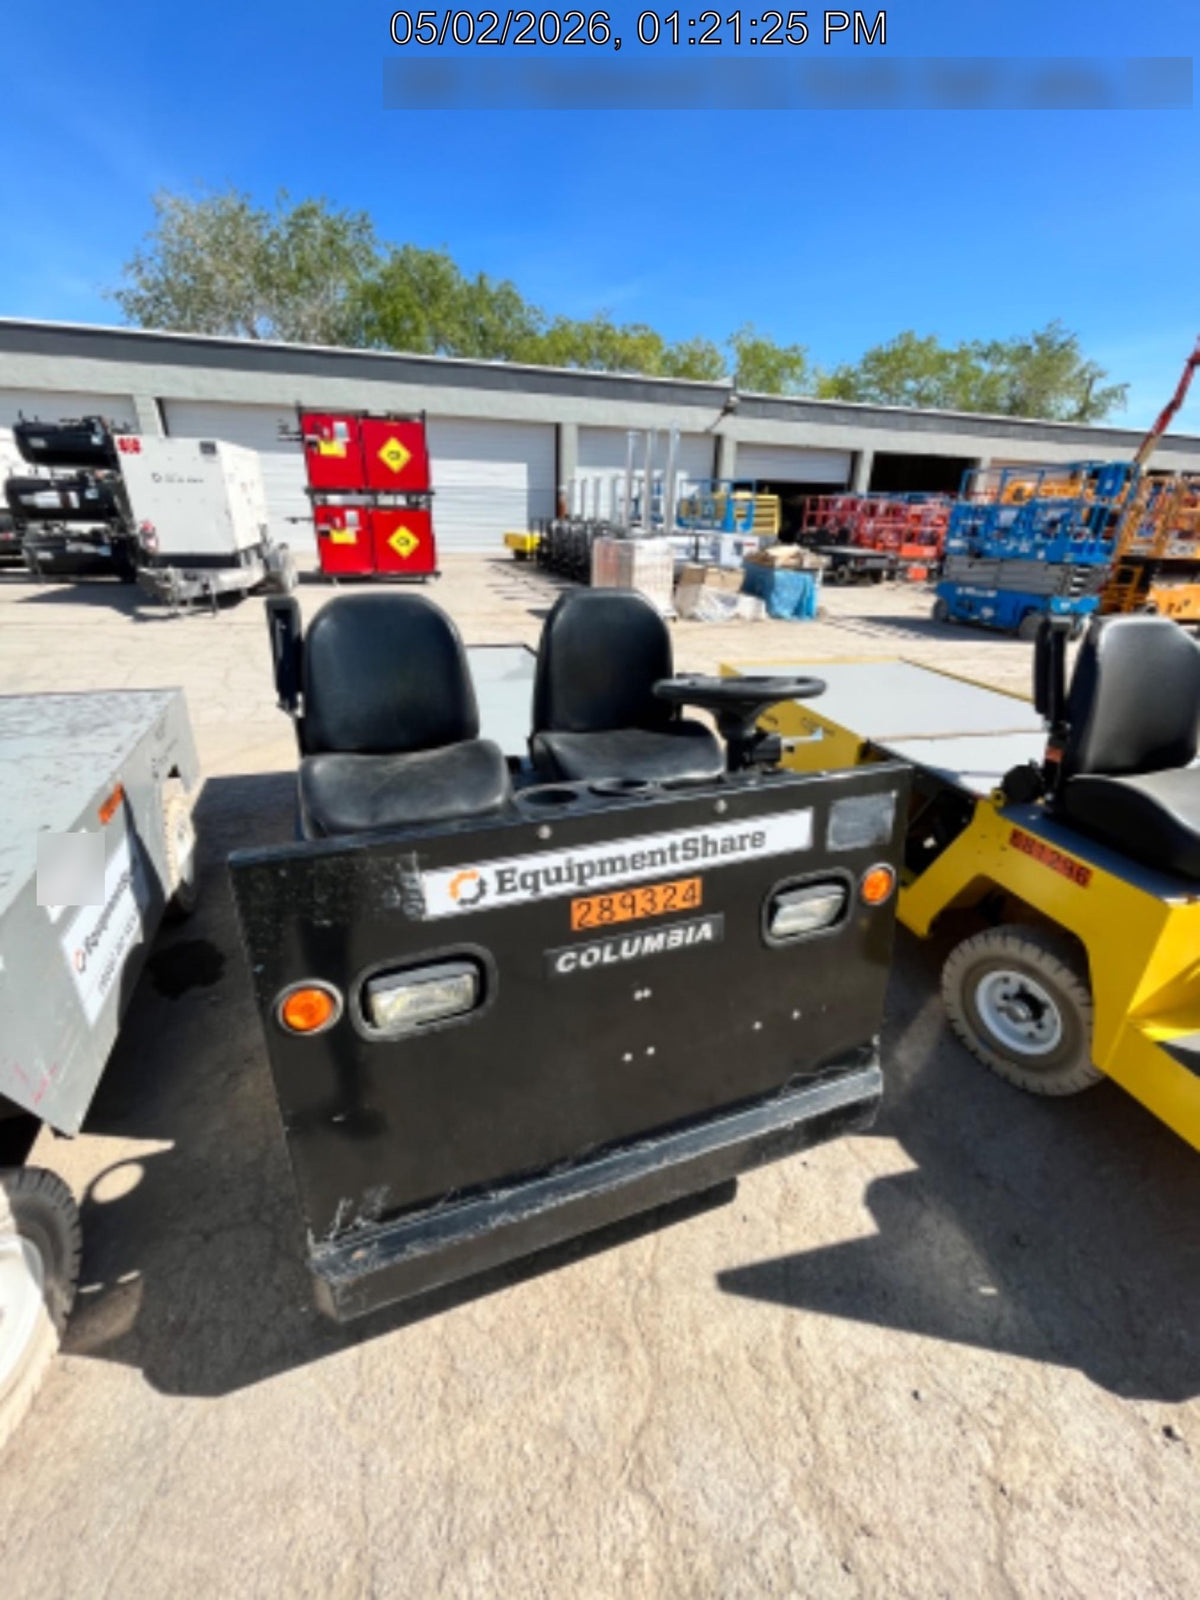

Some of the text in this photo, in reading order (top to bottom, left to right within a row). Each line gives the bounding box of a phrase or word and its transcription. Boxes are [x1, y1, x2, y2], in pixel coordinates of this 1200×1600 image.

[494, 828, 766, 895] EquipmentShare
[577, 884, 699, 928] 289324
[555, 922, 714, 973] COLUMBIA
